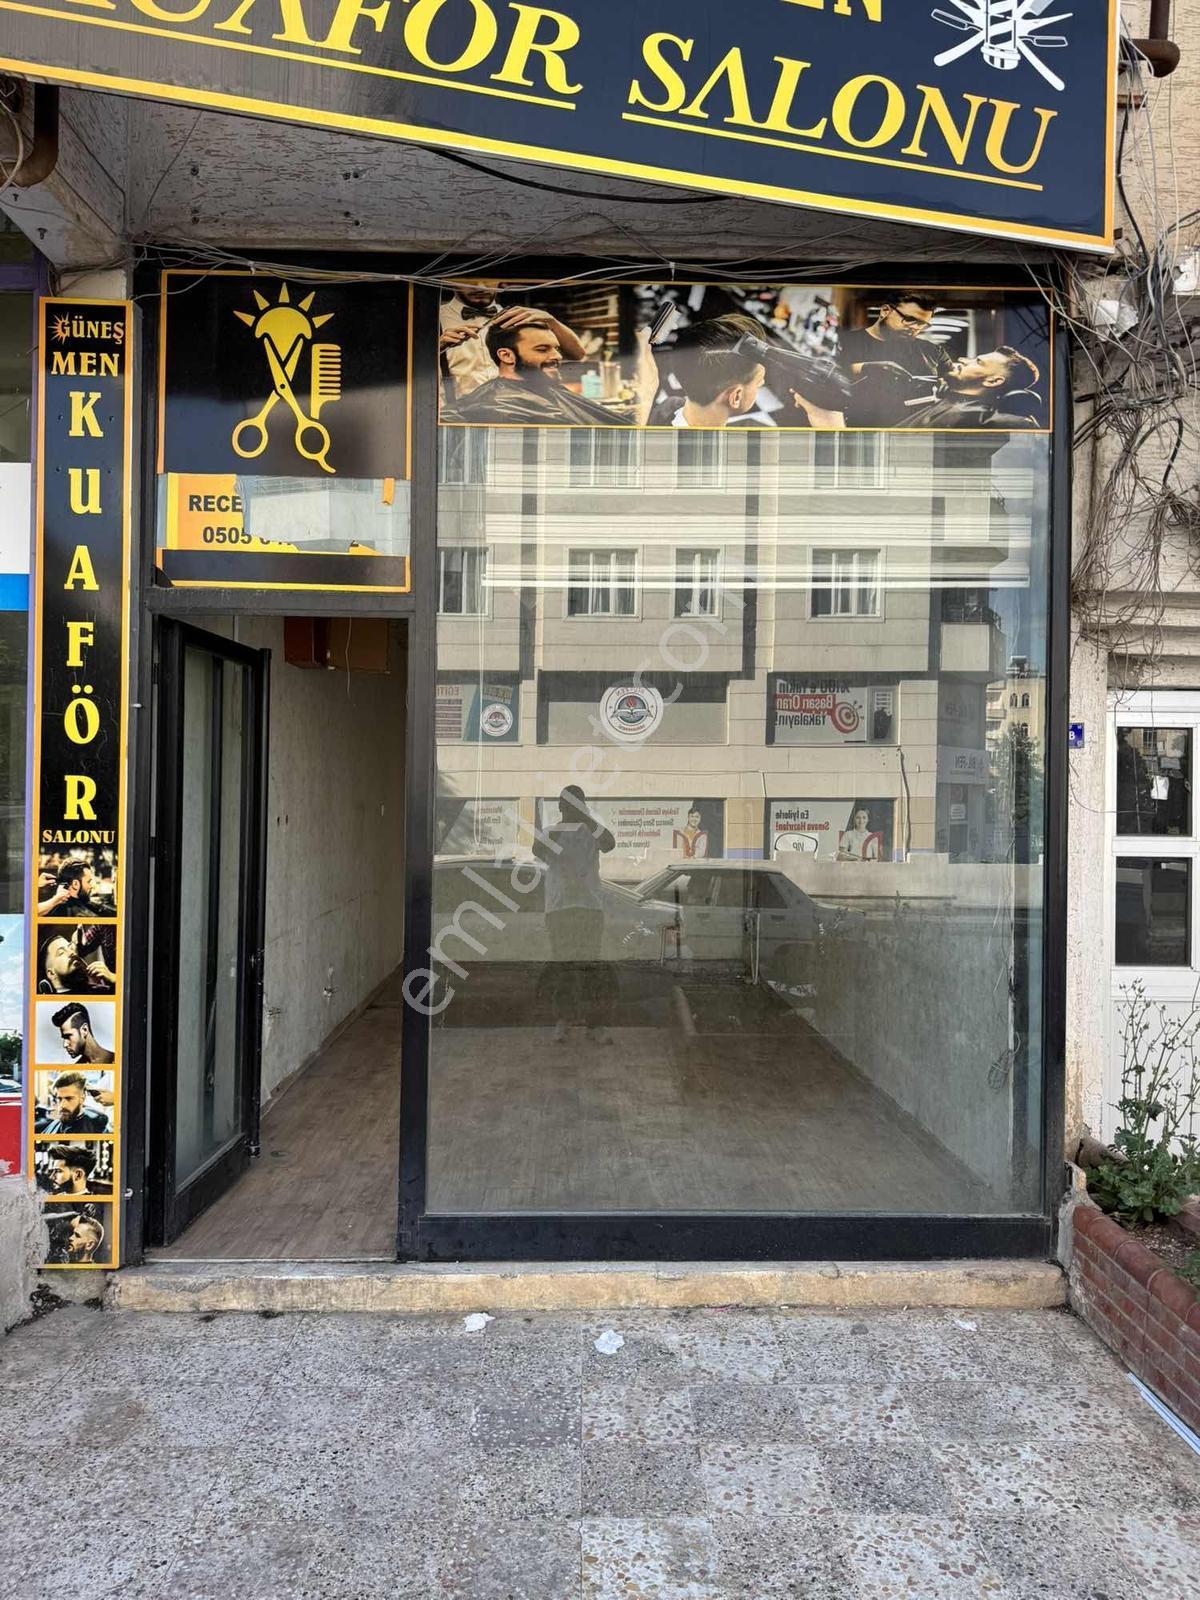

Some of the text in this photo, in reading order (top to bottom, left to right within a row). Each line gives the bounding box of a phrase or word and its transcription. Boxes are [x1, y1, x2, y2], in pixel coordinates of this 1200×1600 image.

[628, 32, 1057, 174] SALONU
[49, 312, 124, 344] GÜNEŞ
[51, 351, 119, 377] MEN
[63, 390, 103, 821] KUAFÖR
[42, 829, 116, 845] SALONU
